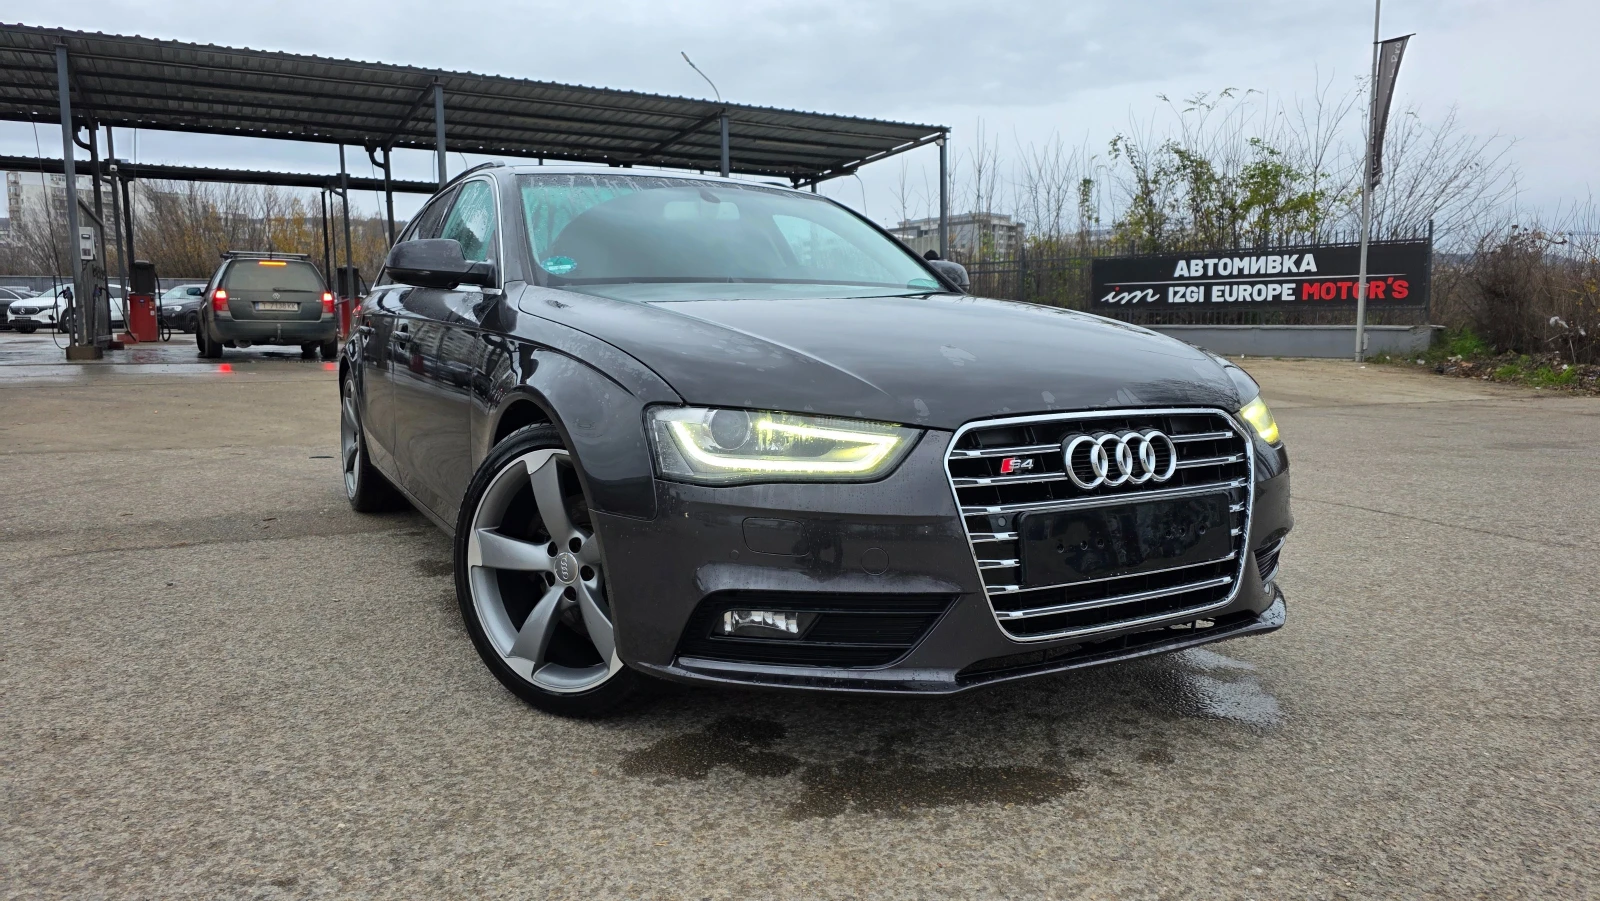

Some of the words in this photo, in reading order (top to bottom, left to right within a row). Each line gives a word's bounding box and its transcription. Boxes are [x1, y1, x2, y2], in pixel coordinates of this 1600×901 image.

[1173, 253, 1318, 278] АВТОМИВКА
[1168, 285, 1205, 303] IZGI
[1211, 283, 1297, 303] EUROPE
[1007, 458, 1034, 470] S4
